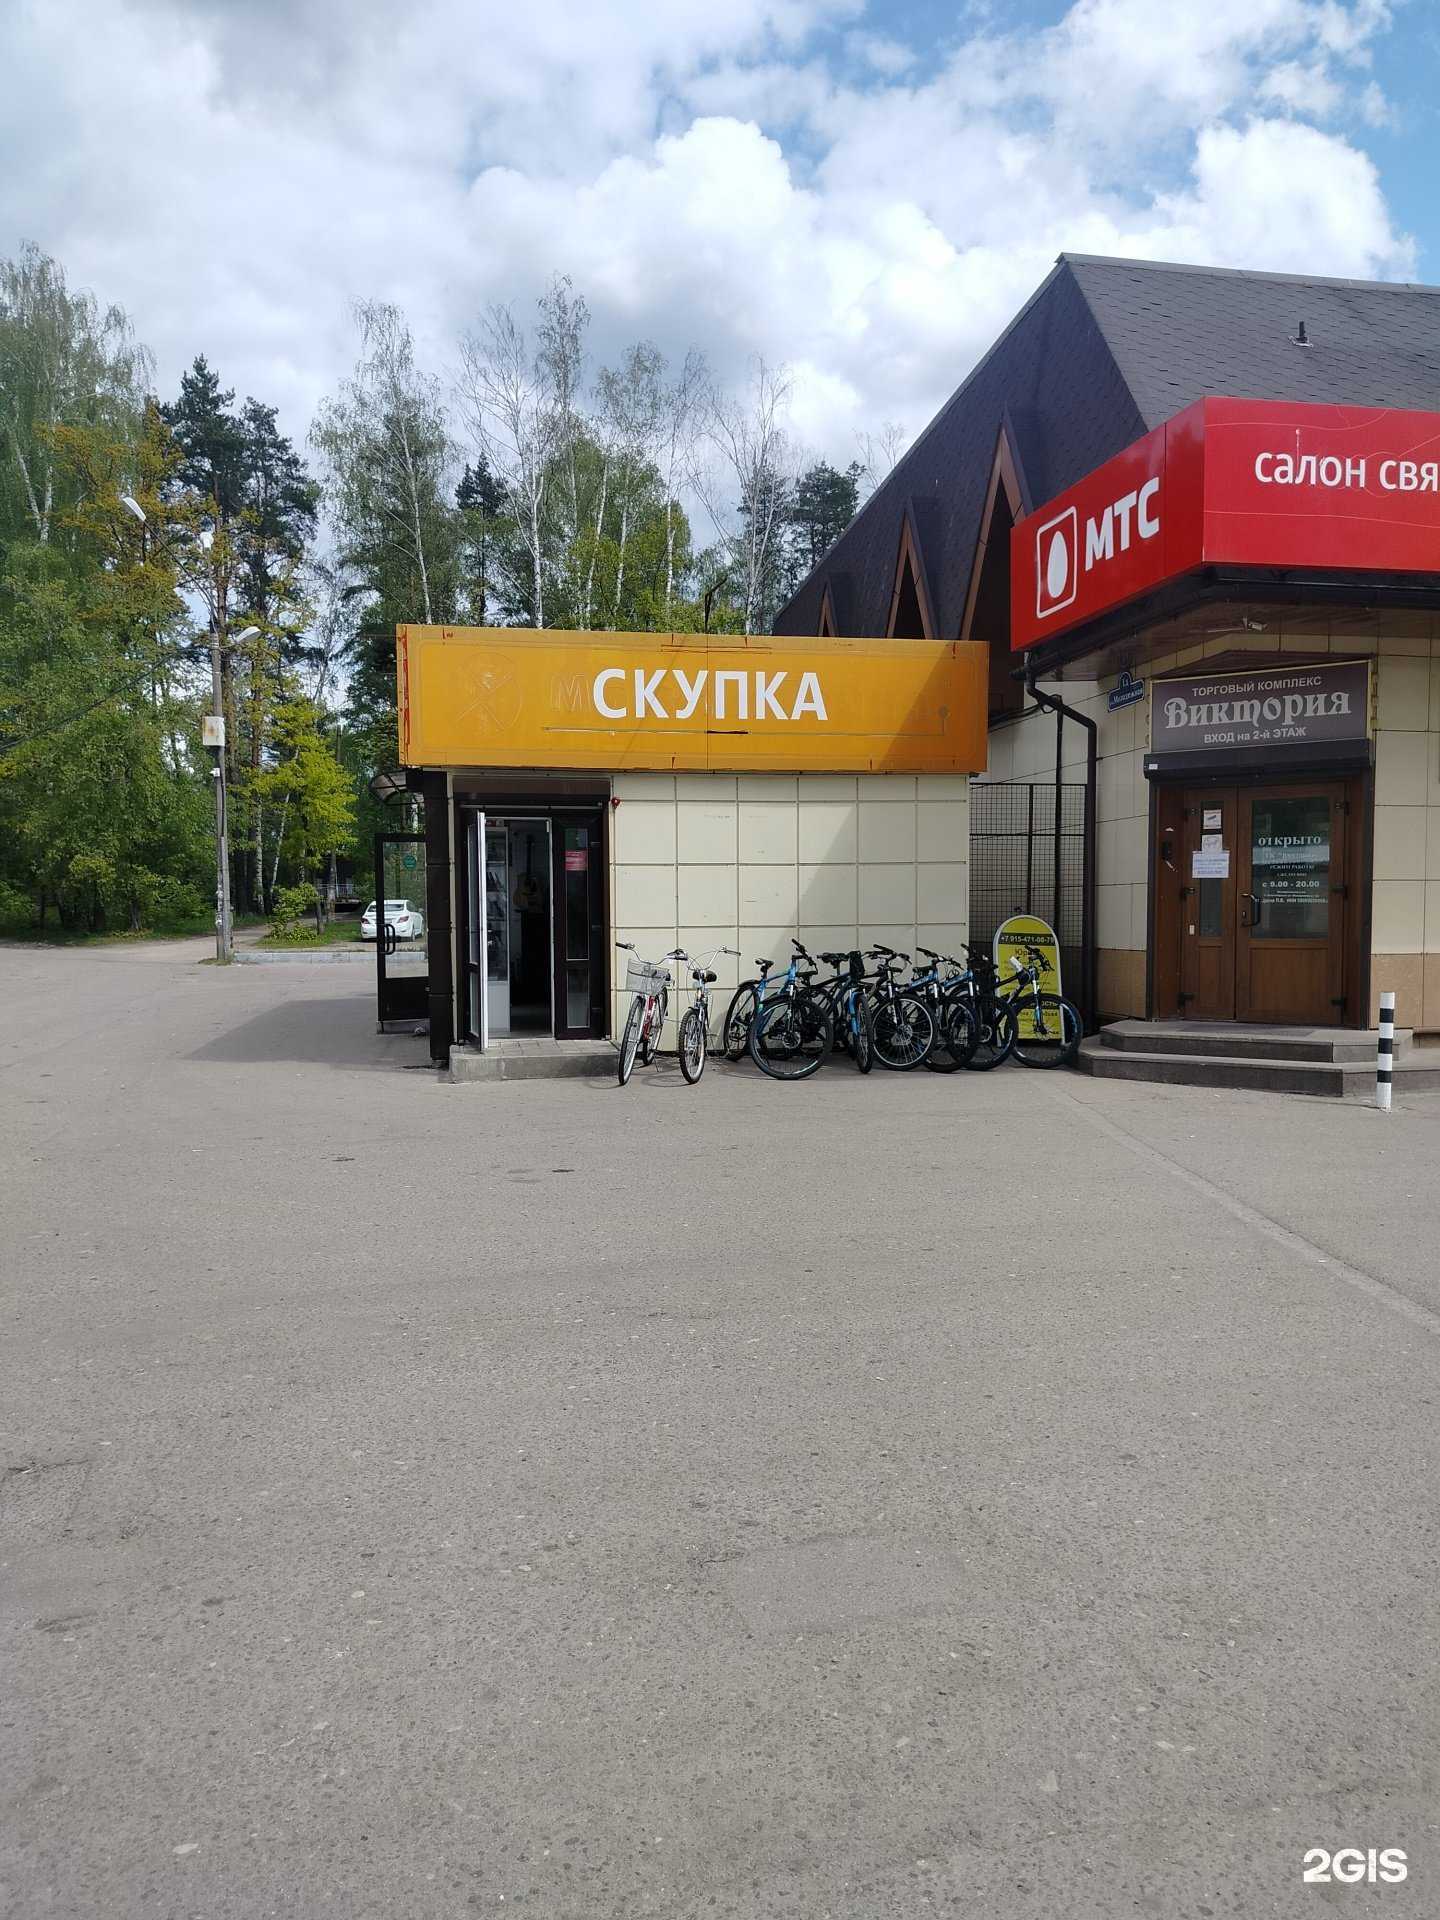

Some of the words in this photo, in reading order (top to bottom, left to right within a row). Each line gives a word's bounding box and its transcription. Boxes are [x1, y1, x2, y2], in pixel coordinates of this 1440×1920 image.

[1255, 452, 1366, 488] салон
[1085, 477, 1160, 572] МТС
[593, 668, 829, 721] СКУПКА
[1192, 680, 1255, 697] ТОРГОВЫЙ
[1258, 676, 1322, 691] КОМПЛЕКС
[1163, 691, 1352, 729] Виктория
[1204, 732, 1235, 744] ВХОД
[1237, 733, 1250, 741] на
[1253, 729, 1270, 741] 2-й
[1272, 727, 1307, 739] ЭТАЖ
[1258, 836, 1322, 848] открыто
